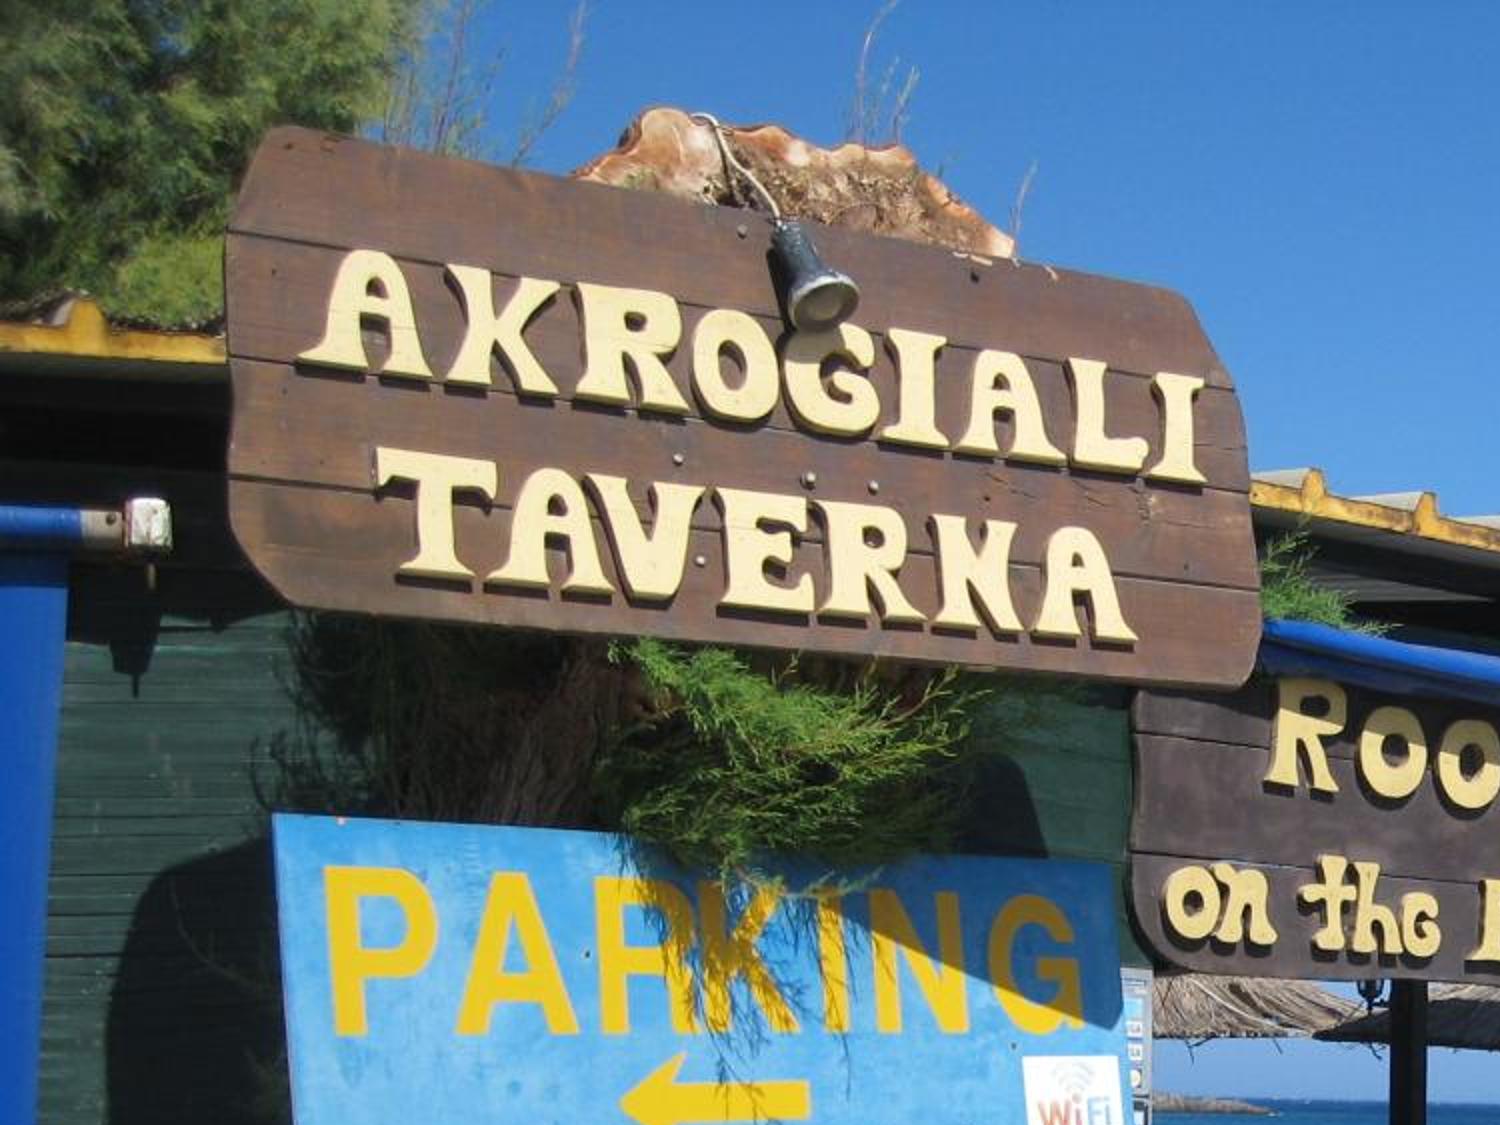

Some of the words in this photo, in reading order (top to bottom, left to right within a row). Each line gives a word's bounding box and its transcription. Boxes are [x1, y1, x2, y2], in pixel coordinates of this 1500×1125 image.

[295, 248, 1206, 486] AKROGIALI
[374, 445, 1139, 646] TAVERNA
[323, 865, 1084, 1037] PARKING
[1164, 862, 1279, 946] on
[1297, 853, 1442, 958] the
